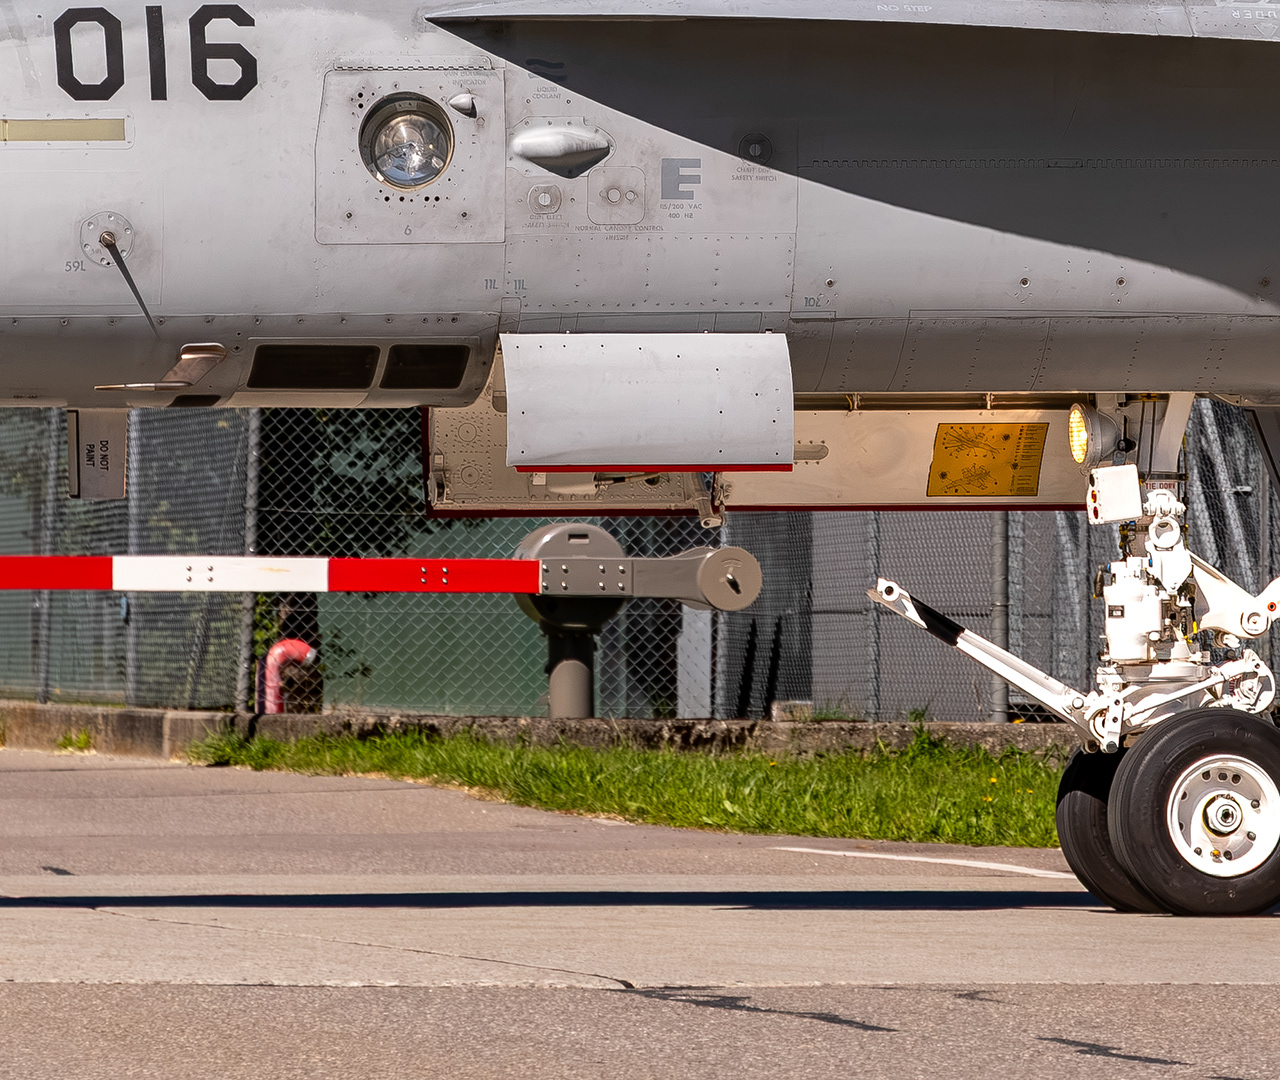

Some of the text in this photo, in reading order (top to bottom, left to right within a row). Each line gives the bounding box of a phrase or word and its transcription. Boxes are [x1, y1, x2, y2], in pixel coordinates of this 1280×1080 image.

[876, 4, 933, 13] NO STEP
[53, 3, 259, 101] 016
[661, 158, 701, 200] E
[404, 224, 412, 236] 6
[65, 260, 86, 272] 59L
[484, 278, 499, 290] 11L
[513, 278, 528, 291] 11L
[86, 443, 96, 468] PAINT
[99, 440, 109, 472] DO NOT
[1145, 482, 1157, 490] TIE
